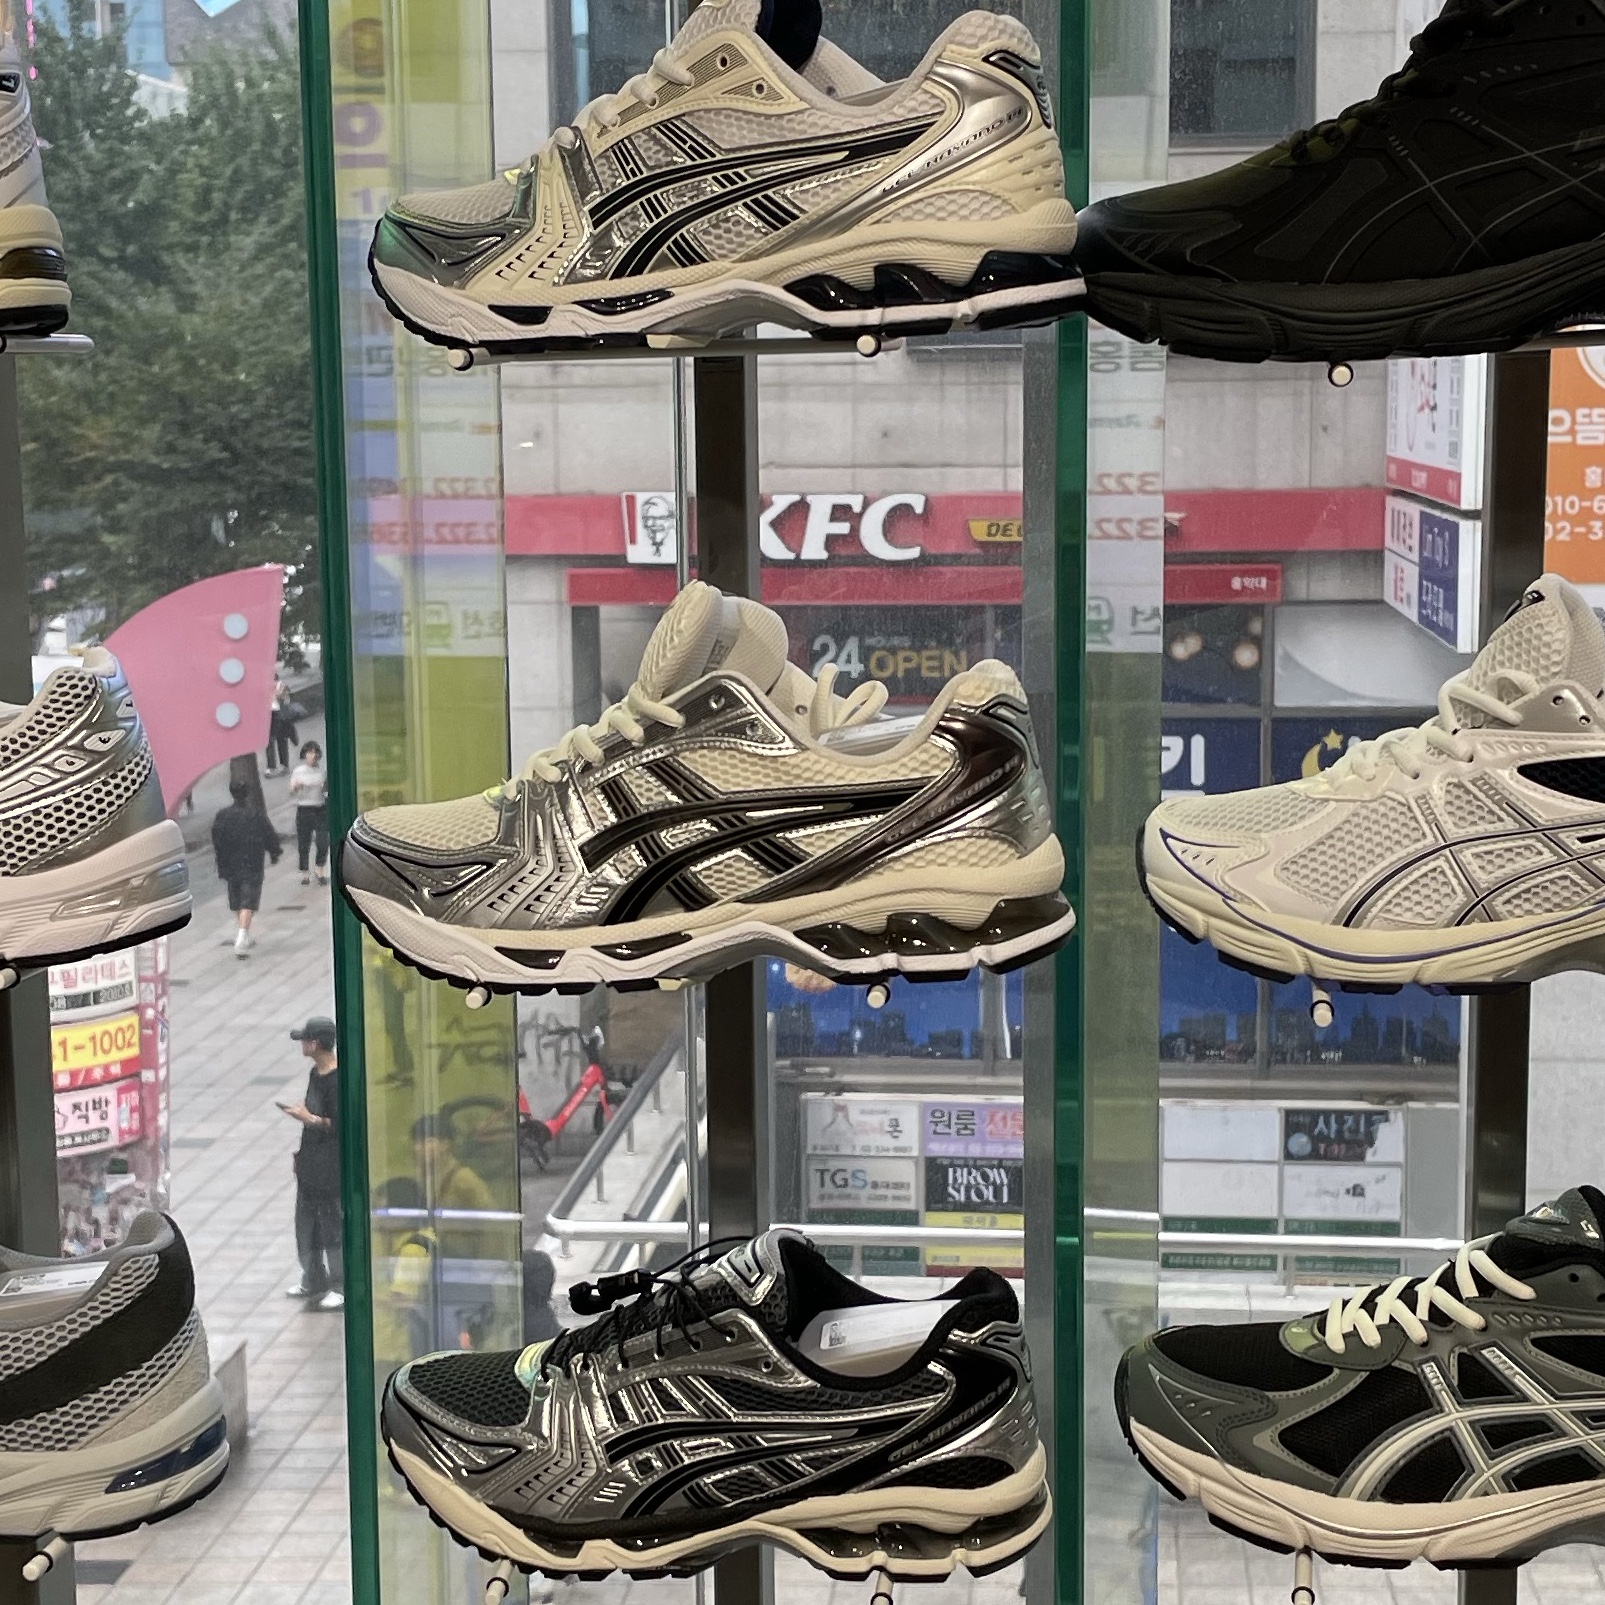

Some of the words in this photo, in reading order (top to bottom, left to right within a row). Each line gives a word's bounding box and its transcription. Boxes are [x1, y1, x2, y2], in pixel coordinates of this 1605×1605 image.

[758, 493, 926, 561] KFC
[812, 634, 865, 679] 24
[868, 648, 968, 679] OPEN
[52, 1023, 136, 1062] 1-1002
[929, 1108, 977, 1137] 원룸
[814, 1167, 869, 1190] TGS
